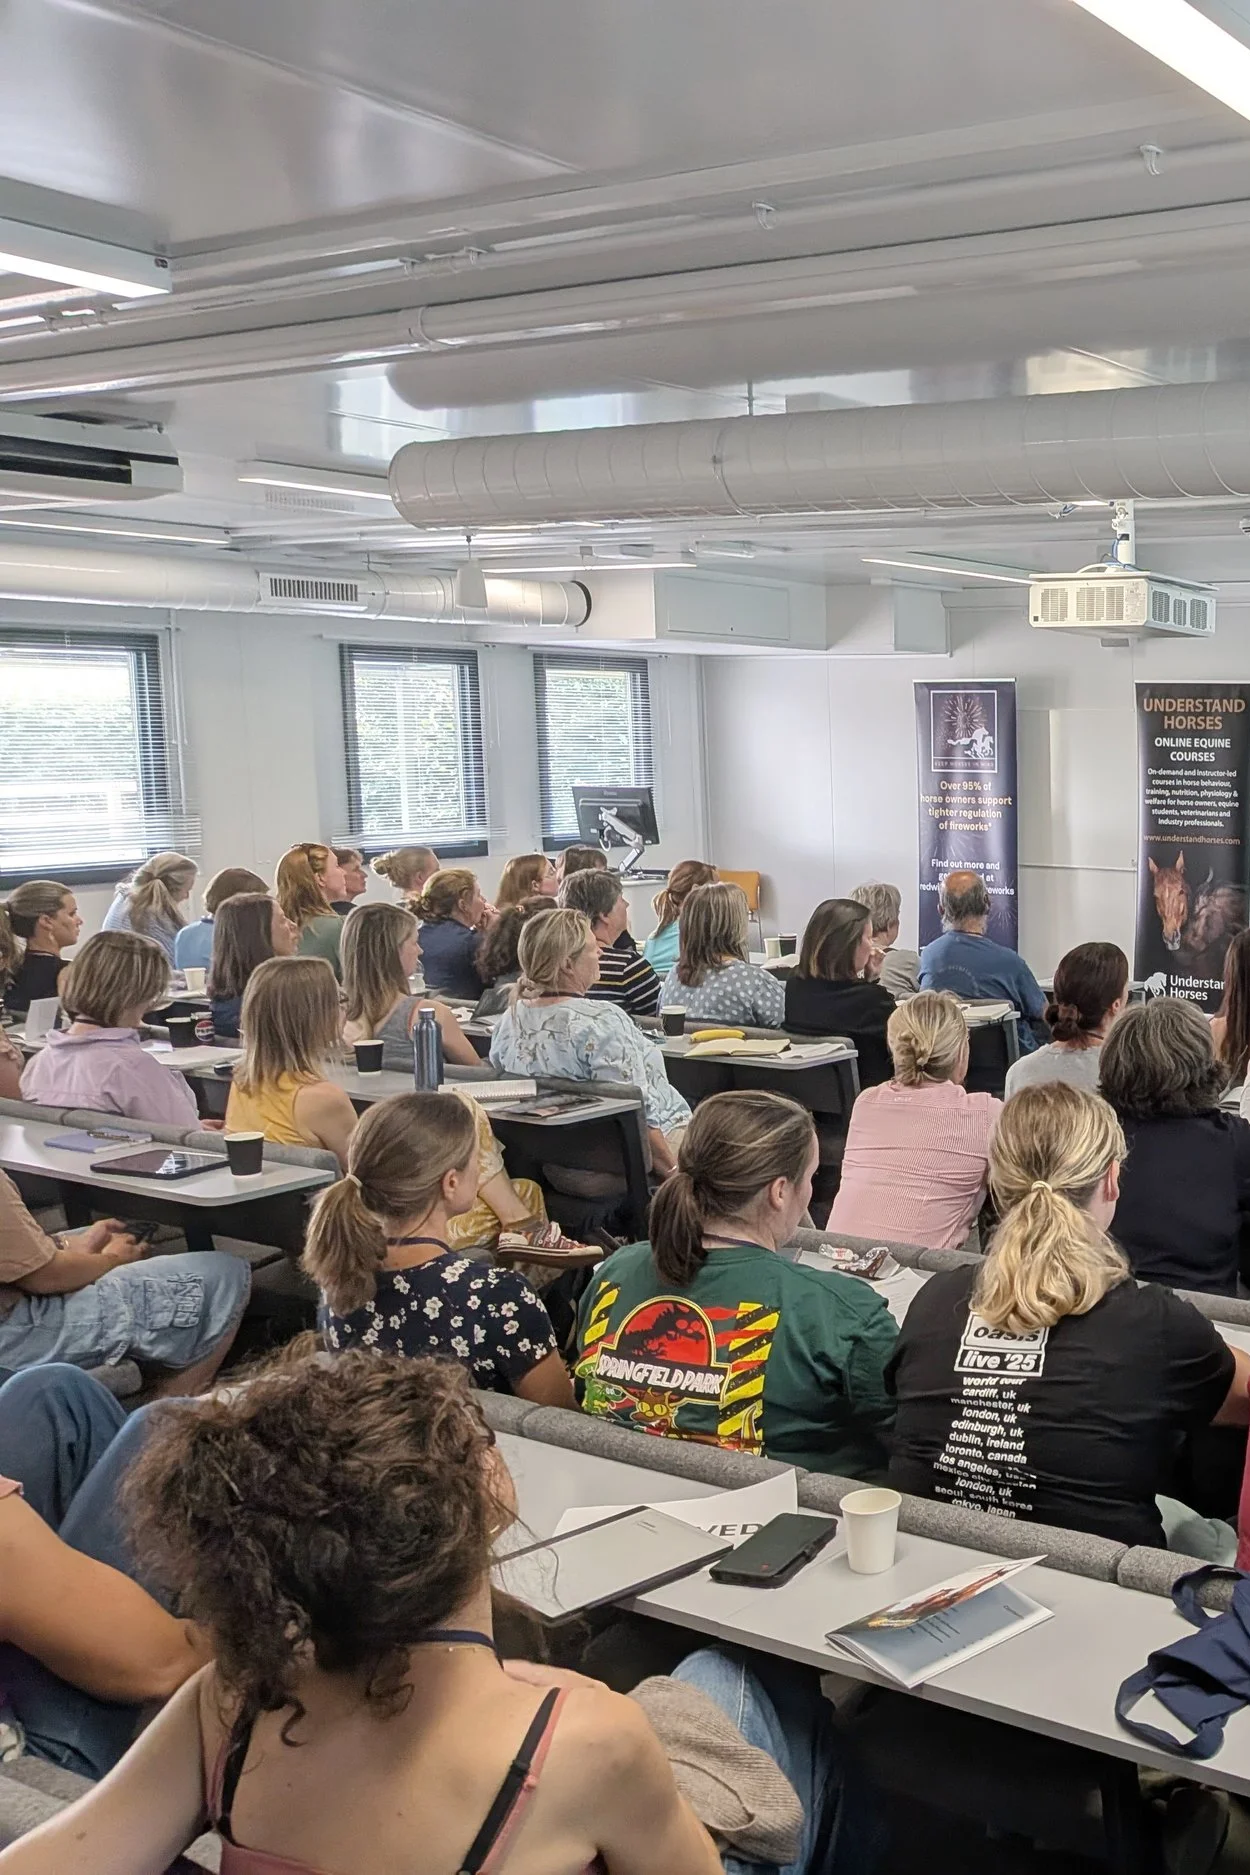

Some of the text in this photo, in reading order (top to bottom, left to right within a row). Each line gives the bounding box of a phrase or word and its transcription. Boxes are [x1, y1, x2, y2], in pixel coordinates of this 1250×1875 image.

[1143, 698, 1246, 713] UNDERSTAND
[1164, 716, 1223, 730] HORSES
[1154, 737, 1231, 748] ONLINE EQUINE
[1170, 751, 1215, 762] COURSES
[1148, 768, 1183, 776] On-demand
[1197, 769, 1237, 778] instructor-led
[940, 781, 992, 791] Over 95% of
[1183, 779, 1200, 787] horse
[1200, 780, 1231, 788] behaviour,
[1145, 788, 1171, 796] training,
[1200, 790, 1232, 799] physiology
[920, 794, 1012, 806] horse owners support
[1218, 801, 1239, 809] equine
[928, 808, 1002, 819] tighter regulation
[1151, 808, 1179, 816] students,
[939, 821, 948, 830] of
[1158, 818, 1224, 827] industry professionals.
[1143, 834, 1240, 845] www.understandhorses.com
[931, 859, 1000, 870] Find out more and
[986, 874, 994, 882] at
[1170, 986, 1208, 1001] Horses
[963, 1351, 1000, 1369] live
[597, 1354, 725, 1394] SPRINGFIELD PARK
[963, 1377, 999, 1386] world
[962, 1388, 1017, 1400] cardiff, uk
[950, 1398, 1031, 1413] manchester, uk
[962, 1407, 1018, 1424] london, uk
[951, 1420, 1024, 1438] edinburgh, uk
[949, 1432, 1025, 1451] dublin, ireland
[945, 1443, 1027, 1464] toronto, canada
[933, 1462, 969, 1478] mexico
[939, 1453, 956, 1465] los
[957, 1460, 1002, 1478] angeles,
[955, 1477, 996, 1495] london,
[999, 1487, 1013, 1497] uk
[987, 1505, 1016, 1518] japan
